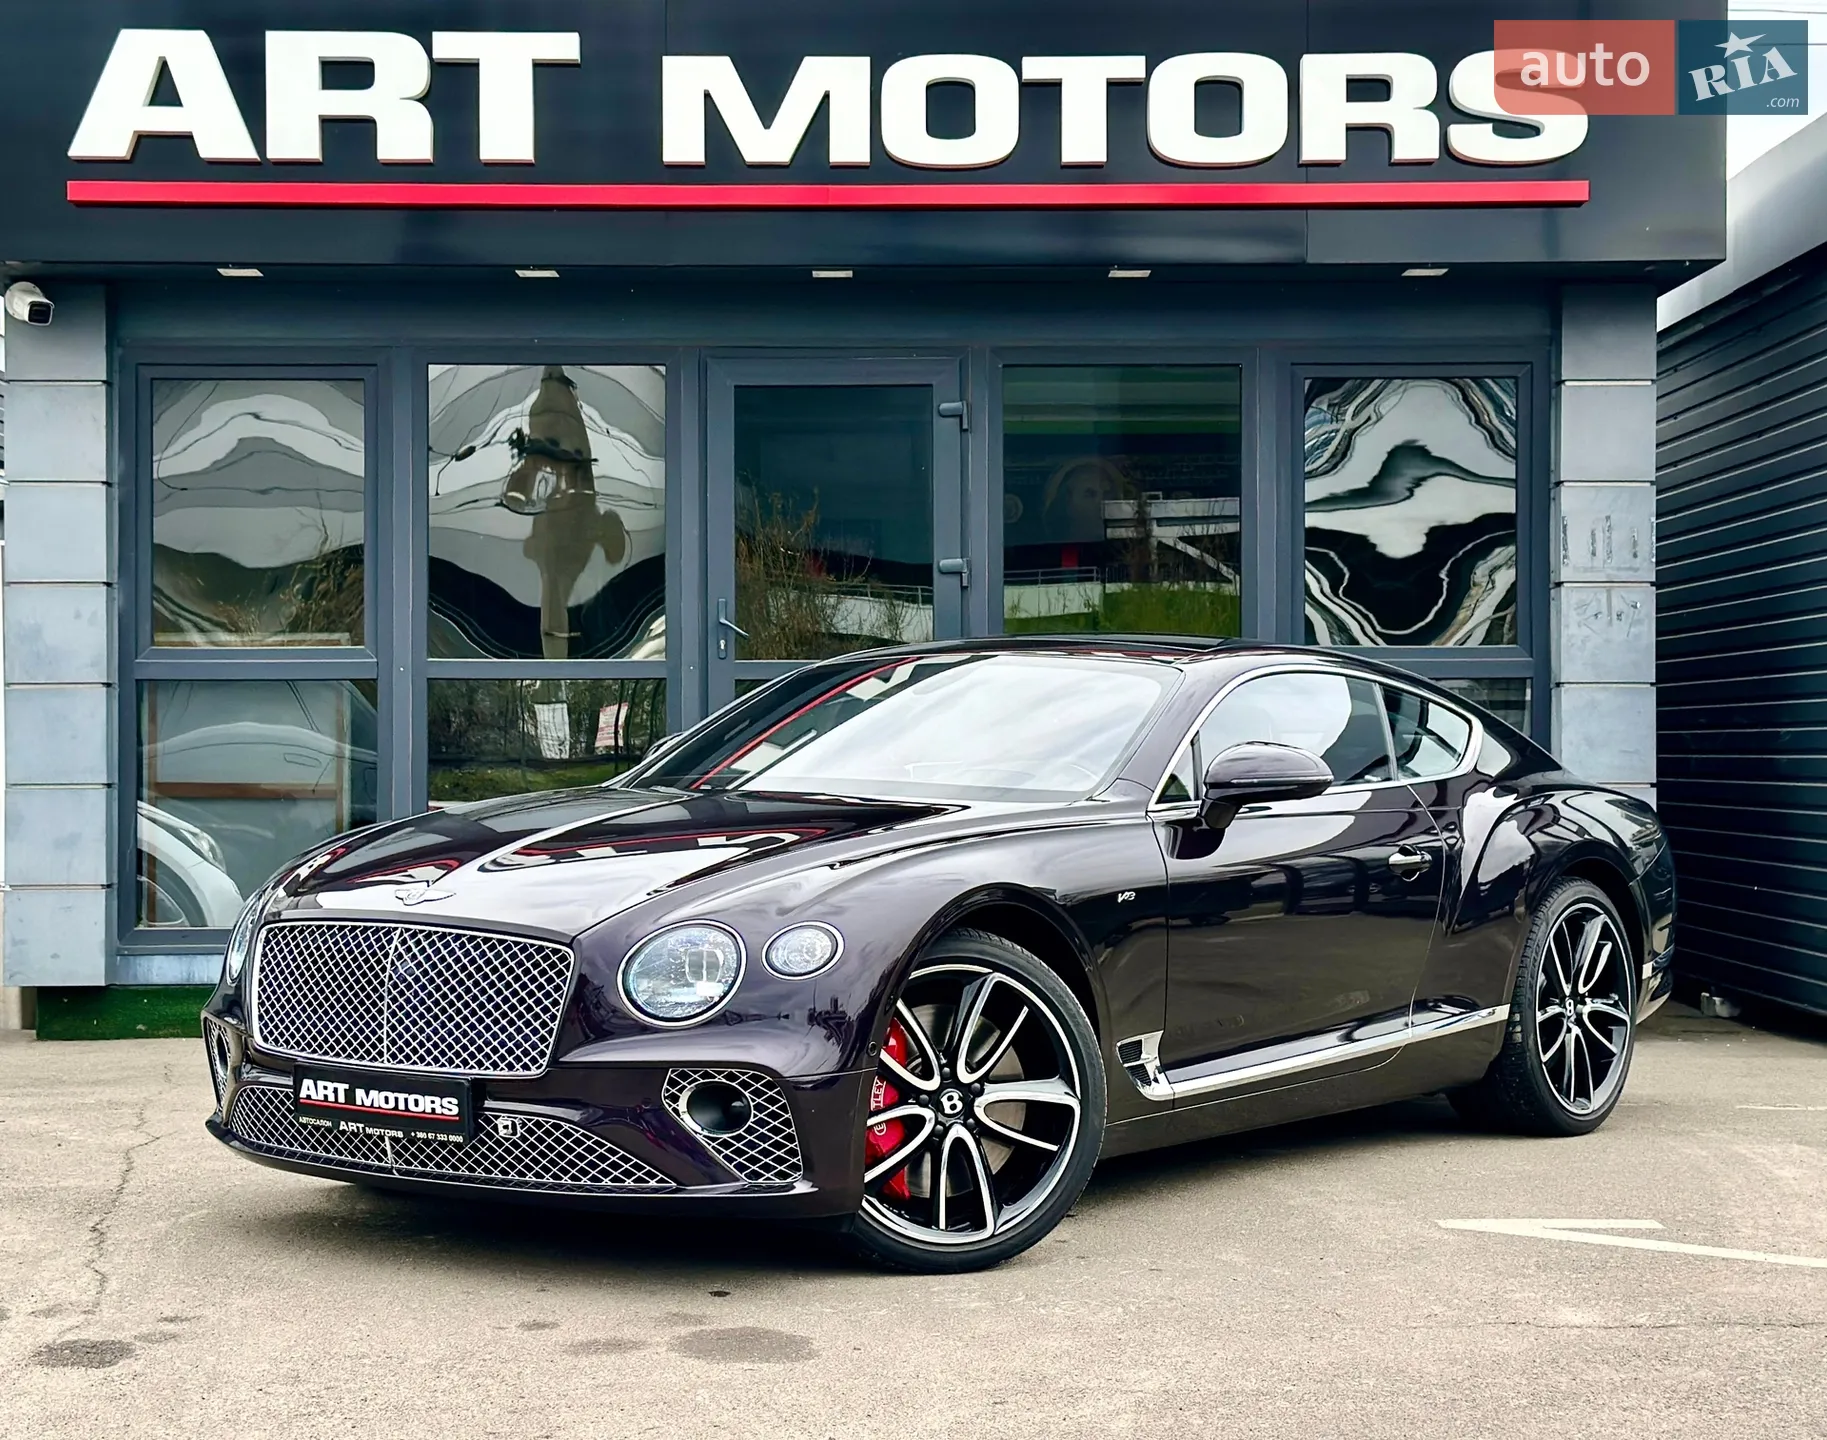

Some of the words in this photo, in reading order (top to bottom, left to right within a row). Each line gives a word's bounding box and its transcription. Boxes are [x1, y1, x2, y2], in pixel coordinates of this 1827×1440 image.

[67, 28, 582, 163] ART
[662, 49, 1589, 168] MOTORS
[299, 1078, 349, 1103] ART
[355, 1088, 459, 1116] MOTORS
[941, 1091, 963, 1114] B
[339, 1120, 364, 1133] ART
[365, 1126, 403, 1138] MOTORS
